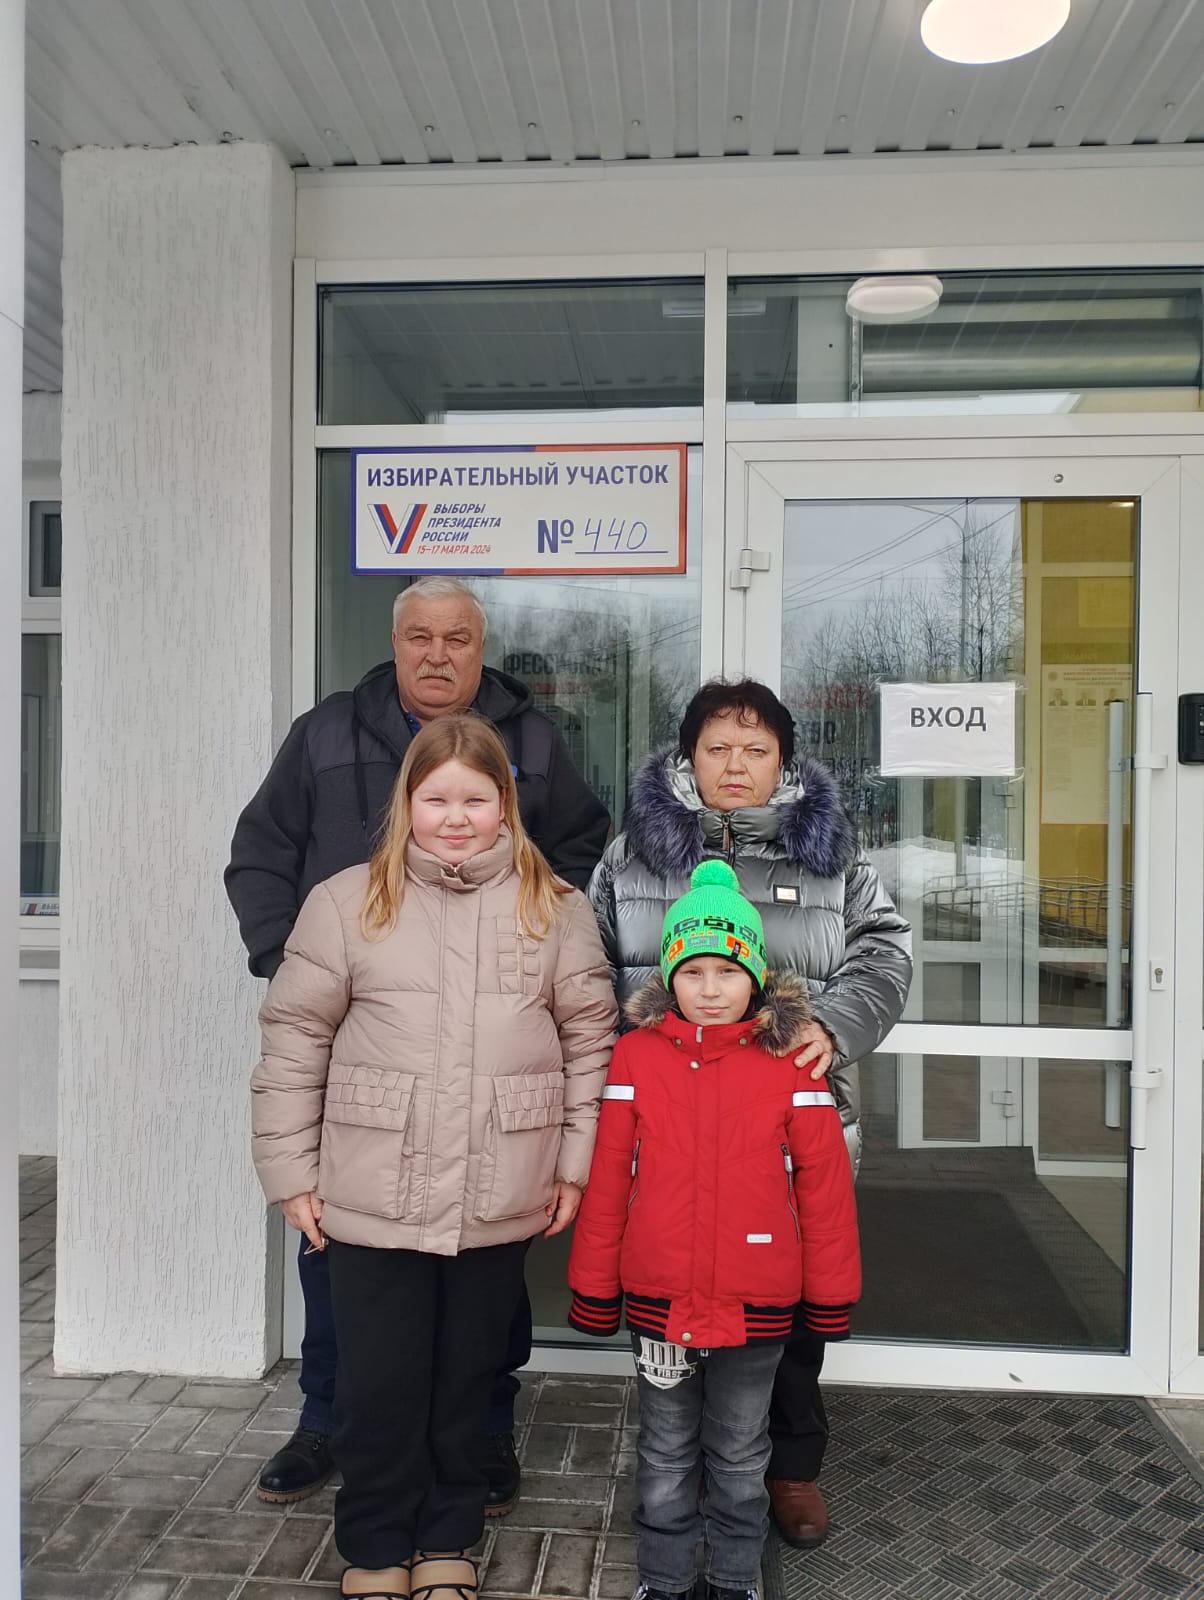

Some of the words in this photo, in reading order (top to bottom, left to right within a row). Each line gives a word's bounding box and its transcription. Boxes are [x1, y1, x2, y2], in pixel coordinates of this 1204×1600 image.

[367, 462, 558, 487] ИЗБИРАТЕЛЬНЫЙ
[566, 464, 669, 485] УЧАСТОК
[433, 503, 486, 514] ВЫБОРЫ
[427, 517, 502, 529] ПРЕЗИДЕНТА
[421, 531, 470, 542] РОССИИ
[584, 517, 648, 552] 440
[440, 544, 470, 554] МАРТА
[470, 544, 492, 554] 2024
[910, 706, 987, 732] ВХОД
[656, 1368, 683, 1379] FIRST
